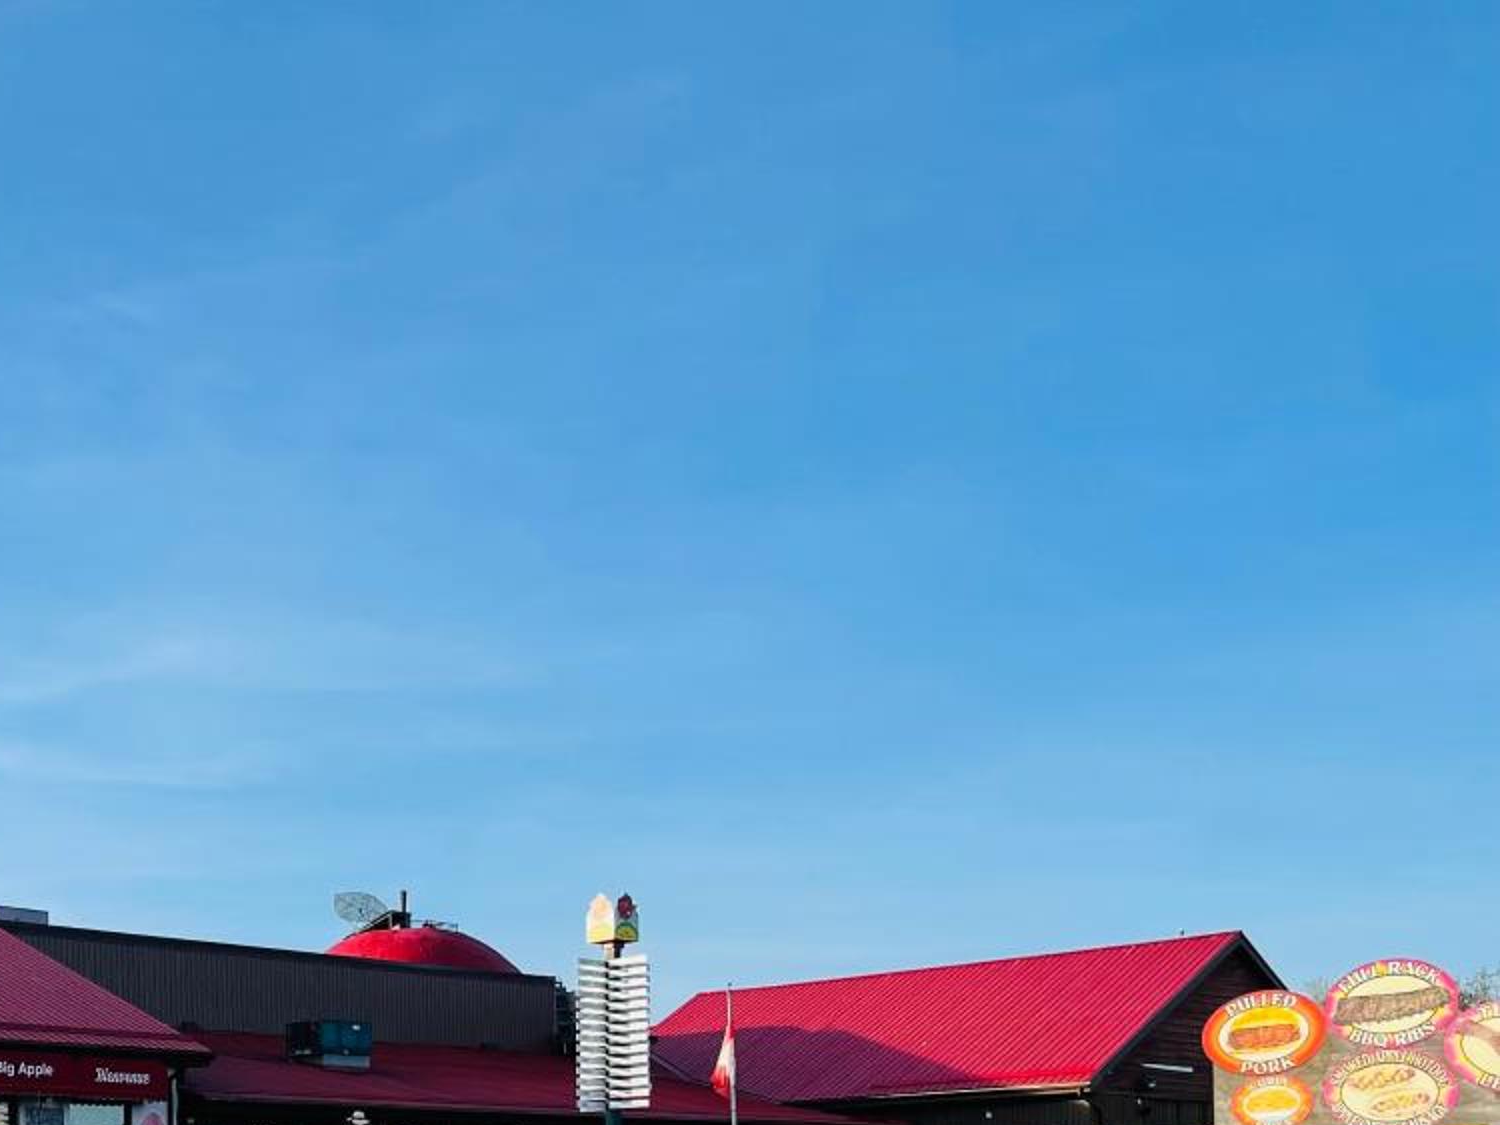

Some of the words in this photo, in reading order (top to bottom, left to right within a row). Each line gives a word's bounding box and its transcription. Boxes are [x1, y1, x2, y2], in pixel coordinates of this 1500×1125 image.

[1388, 961, 1438, 983] RACK
[1225, 993, 1297, 1018] PULLED
[1349, 1028, 1388, 1048] BBQ
[1395, 1020, 1437, 1046] RIBS
[18, 1062, 53, 1078] Apple
[1241, 1056, 1295, 1075] PORK
